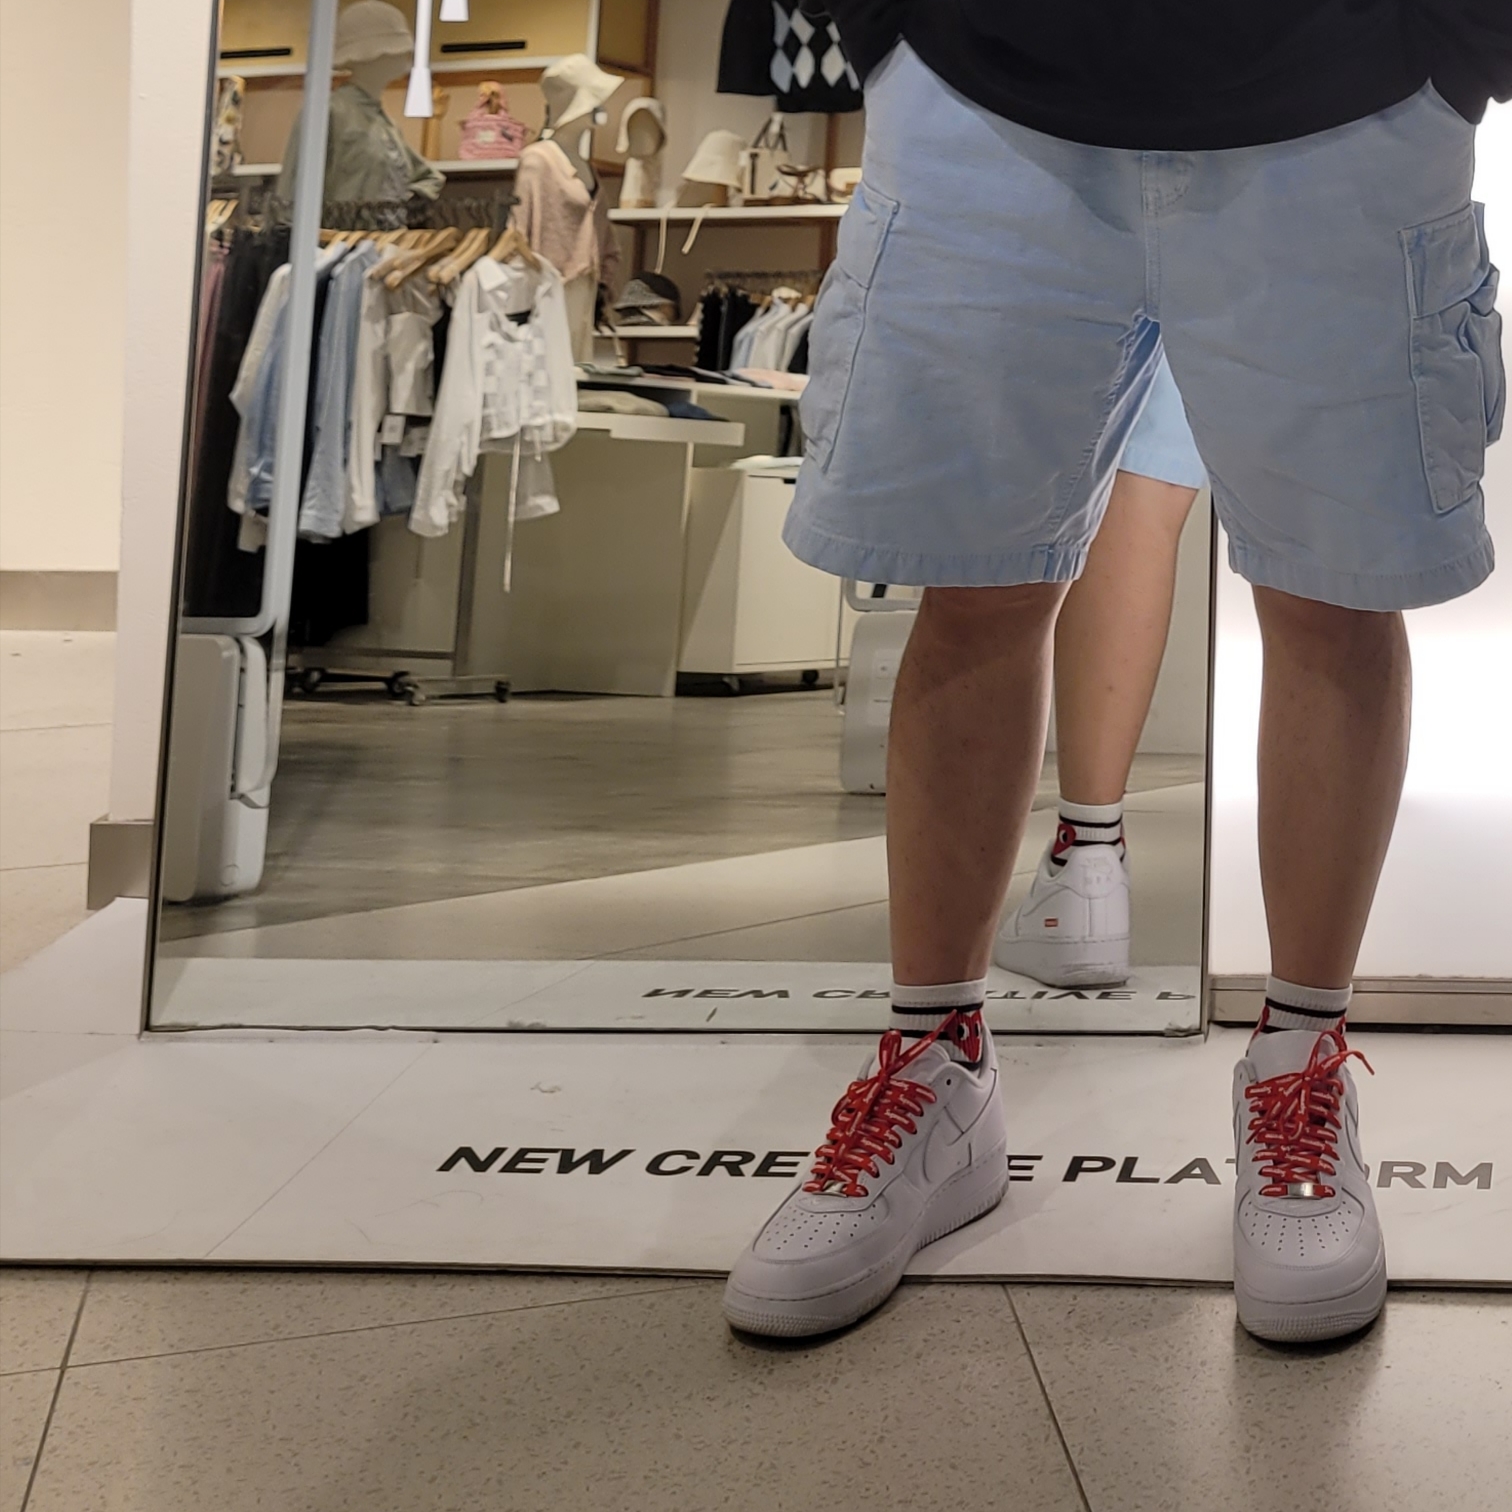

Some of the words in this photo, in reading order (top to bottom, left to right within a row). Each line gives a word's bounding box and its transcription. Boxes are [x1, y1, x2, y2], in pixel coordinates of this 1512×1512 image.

[435, 1146, 637, 1176] NEW
[644, 1149, 1044, 1182] CREE
[1061, 1155, 1494, 1189] PLARM
